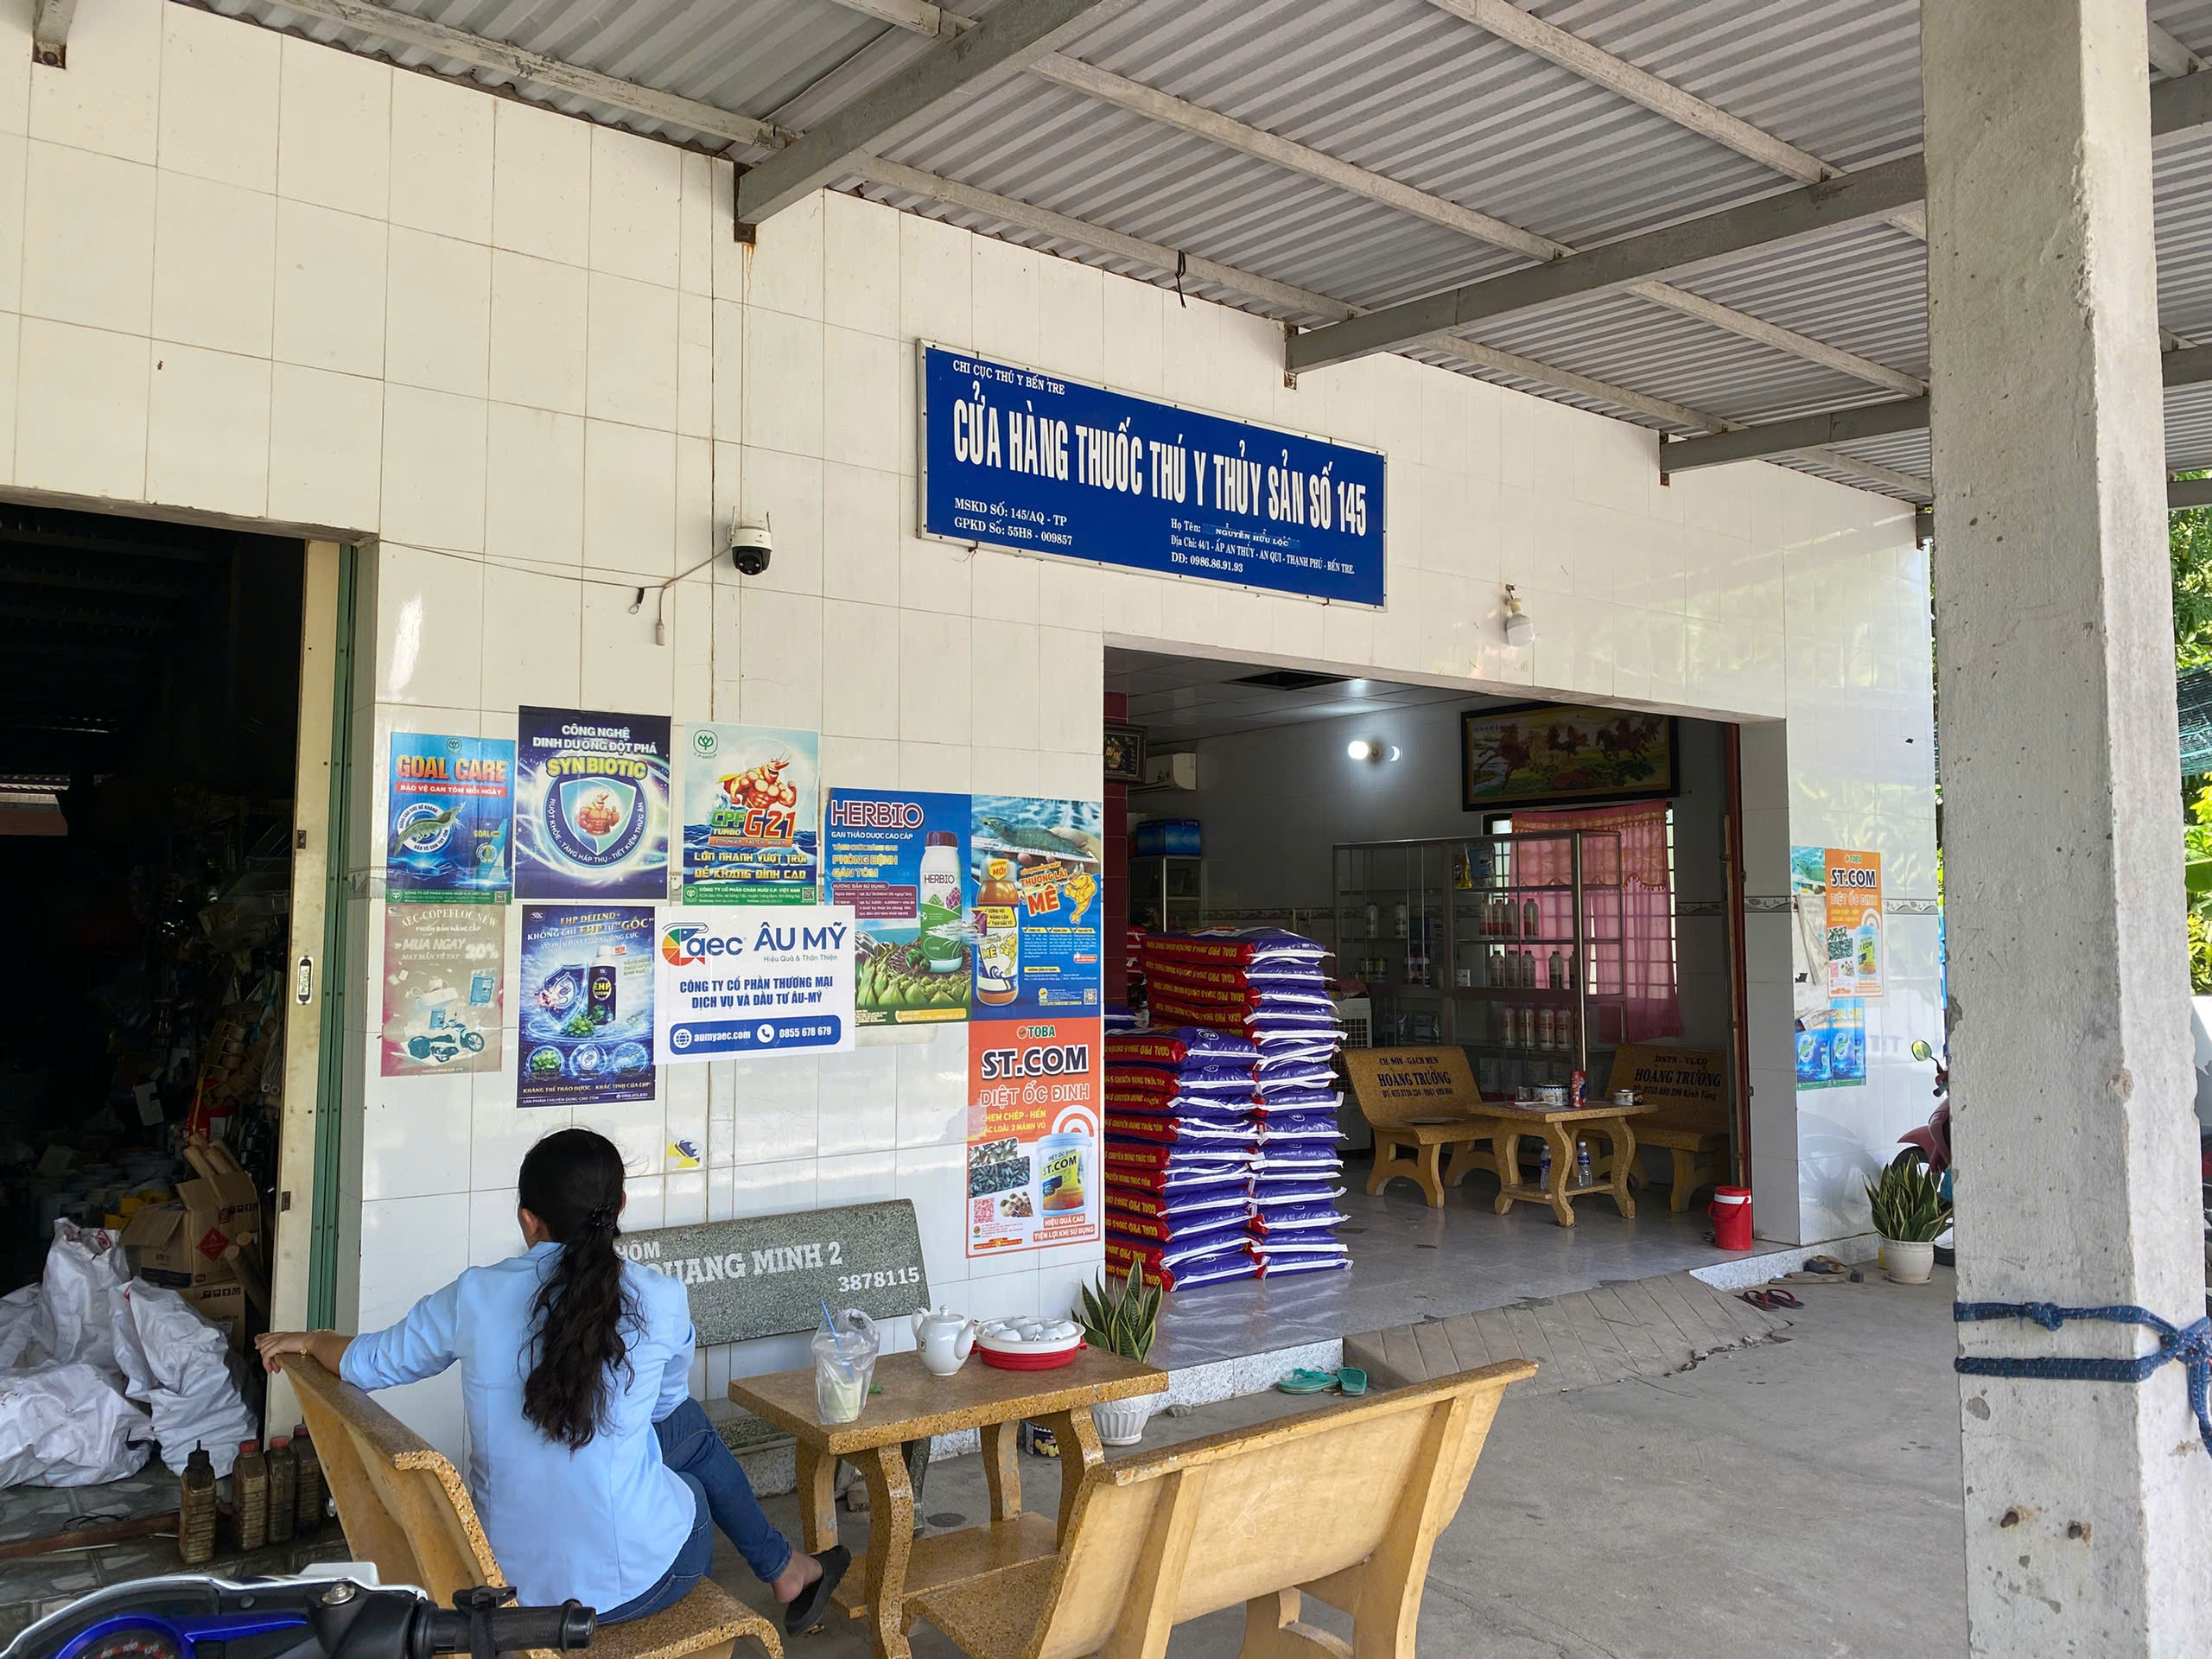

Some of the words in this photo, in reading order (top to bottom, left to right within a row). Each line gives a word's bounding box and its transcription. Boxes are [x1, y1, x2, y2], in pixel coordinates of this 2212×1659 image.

[953, 359, 970, 374] CHI
[973, 365, 993, 379] CỤC
[995, 369, 1014, 384] THÚ
[1016, 374, 1023, 386] Y
[1026, 374, 1045, 391] BẾN
[1046, 379, 1065, 395] TRE
[953, 380, 1001, 468] CỬA
[1008, 399, 1069, 481] HÀNG
[1075, 416, 1143, 495] THUỐC
[1149, 433, 1186, 504] THÚ
[1193, 450, 1207, 506] Y
[1213, 439, 1262, 517] THỦY
[1268, 448, 1305, 524] SẢN
[1309, 461, 1333, 531] SỐ
[1338, 480, 1367, 537] 145
[954, 498, 988, 513] MSKD
[989, 500, 1008, 518] SỐ:
[1011, 507, 1045, 526] 145/AQ
[1052, 514, 1068, 527] TP
[954, 517, 987, 532] GPKD
[988, 519, 1005, 535] Số:
[1007, 524, 1033, 539] 55H8
[1040, 531, 1073, 546] 009857
[1170, 518, 1182, 531] Họ
[1184, 520, 1201, 533] Tên:
[1215, 523, 1251, 541] NGUYỄN
[1170, 535, 1182, 548] Địa
[1198, 539, 1210, 551] 44/1
[1215, 538, 1224, 553] ẤP
[1226, 544, 1236, 555] AN
[1259, 550, 1269, 561] AN
[1269, 551, 1282, 563] QUI
[1309, 556, 1324, 570] PHÚ
[1326, 558, 1340, 573] BẾN
[1171, 551, 1188, 564] DĐ:
[1190, 555, 1244, 574] 0986.86.91.93
[562, 723, 596, 738] CÔNG
[596, 727, 631, 739] NGHỆ
[532, 736, 563, 749] DINH
[608, 740, 633, 755] ĐỘT
[634, 741, 658, 754] PHÁ
[397, 754, 449, 780] GOAL
[454, 758, 508, 782] CARE
[546, 755, 648, 780] SYNBIOTIC
[448, 785, 465, 794] TÔM
[547, 798, 556, 820] RUỘT
[831, 800, 925, 830] HERBIO
[711, 808, 747, 828] CPF
[743, 807, 797, 839] G21
[712, 828, 741, 836] TURBO
[718, 852, 753, 863] NHANH
[783, 869, 807, 880] CAO
[924, 874, 955, 884] HERBIO
[992, 867, 1007, 876] MỚI
[1020, 874, 1054, 887] THƯƠNG
[1054, 868, 1068, 880] LÁI
[1830, 868, 1877, 888] ST.COM
[1027, 884, 1060, 916] MÊ
[560, 916, 579, 925] EHP
[579, 925, 603, 936] EHP
[402, 938, 431, 950] MUA
[433, 938, 467, 950] NGAY
[686, 937, 743, 957] aec
[753, 921, 796, 952] ÂU
[803, 921, 848, 950] MỸ
[764, 955, 779, 963] Hiệu
[819, 953, 837, 963] Thiện
[982, 944, 998, 959] MÊ
[593, 982, 612, 991] EHP
[679, 978, 709, 994] CÔNG
[711, 980, 724, 993] TY
[726, 975, 741, 992] CỔ
[744, 975, 771, 991] PHẦN
[773, 976, 812, 990] THƯƠNG
[815, 976, 834, 989] MẠI
[691, 995, 717, 1011] DỊCH
[721, 995, 734, 1009] VỤ
[736, 992, 750, 1007] VÀ
[753, 990, 773, 1006] ĐẦU
[776, 993, 790, 1005] TƯ
[791, 990, 823, 1004] ÂU-MỸ
[694, 1031, 751, 1043] aumyaec.com
[779, 1027, 800, 1039] 0855
[802, 1027, 816, 1037] 678
[817, 1026, 832, 1036] 679
[1027, 1026, 1056, 1039] TOBA
[1140, 1045, 1153, 1055] PRO
[1154, 1046, 1170, 1057] GOAL
[981, 1044, 1090, 1080] ST.COM
[1376, 1067, 1413, 1087] HOÀNG
[1413, 1065, 1452, 1086] TRƯỞNG
[1634, 1064, 1674, 1084] HOÀNG
[1675, 1065, 1722, 1087] TRƯỞNG
[980, 1084, 1020, 1109] DIỆT
[1022, 1080, 1048, 1105] ỐC
[1051, 1083, 1090, 1103] ĐINH
[982, 1112, 1002, 1122] HEM
[1003, 1109, 1024, 1121] CHÉP
[1030, 1106, 1046, 1118] HẾN
[1043, 1155, 1077, 1176] ST.COM
[1128, 1200, 1140, 1211] PRO
[1141, 1202, 1157, 1214] GOAL
[1045, 1217, 1059, 1227] HIỆU
[1059, 1216, 1071, 1225] QUẢ
[1128, 1223, 1141, 1233] PRO
[1033, 1230, 1047, 1241] TIỆN
[1047, 1230, 1058, 1240] LỢI
[1058, 1230, 1070, 1238] KHI
[1078, 1225, 1095, 1236] DỤNG
[1141, 1224, 1158, 1236] GOAL
[1119, 1248, 1131, 1259] PRO
[646, 1253, 747, 1284] UANG
[751, 1243, 823, 1275] MINH
[828, 1241, 842, 1266] 2
[837, 1267, 920, 1293] 3878115
[100, 1649, 113, 1658] 80
[123, 1641, 138, 1652] 100
[144, 1644, 160, 1655] 120
